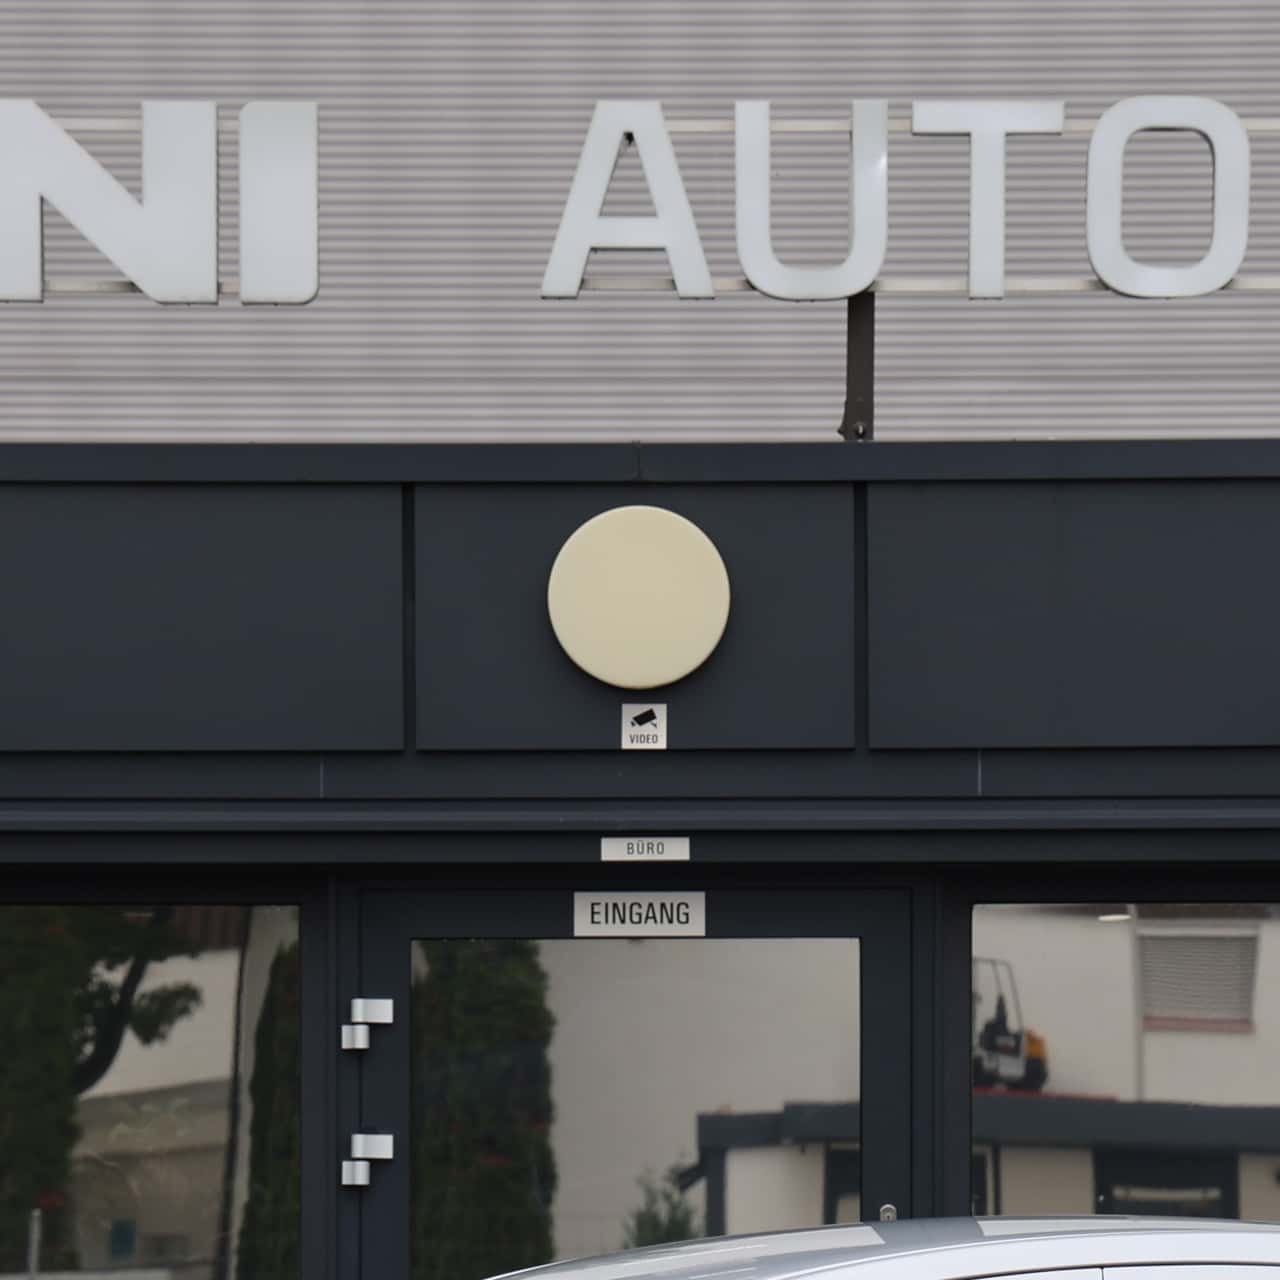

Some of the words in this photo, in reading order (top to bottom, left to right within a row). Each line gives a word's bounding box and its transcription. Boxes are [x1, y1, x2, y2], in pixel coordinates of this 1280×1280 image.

[540, 95, 1250, 302] AUTO
[629, 734, 658, 744] VIDEO
[626, 840, 665, 855] BÜRO
[590, 901, 690, 925] EINGANG
